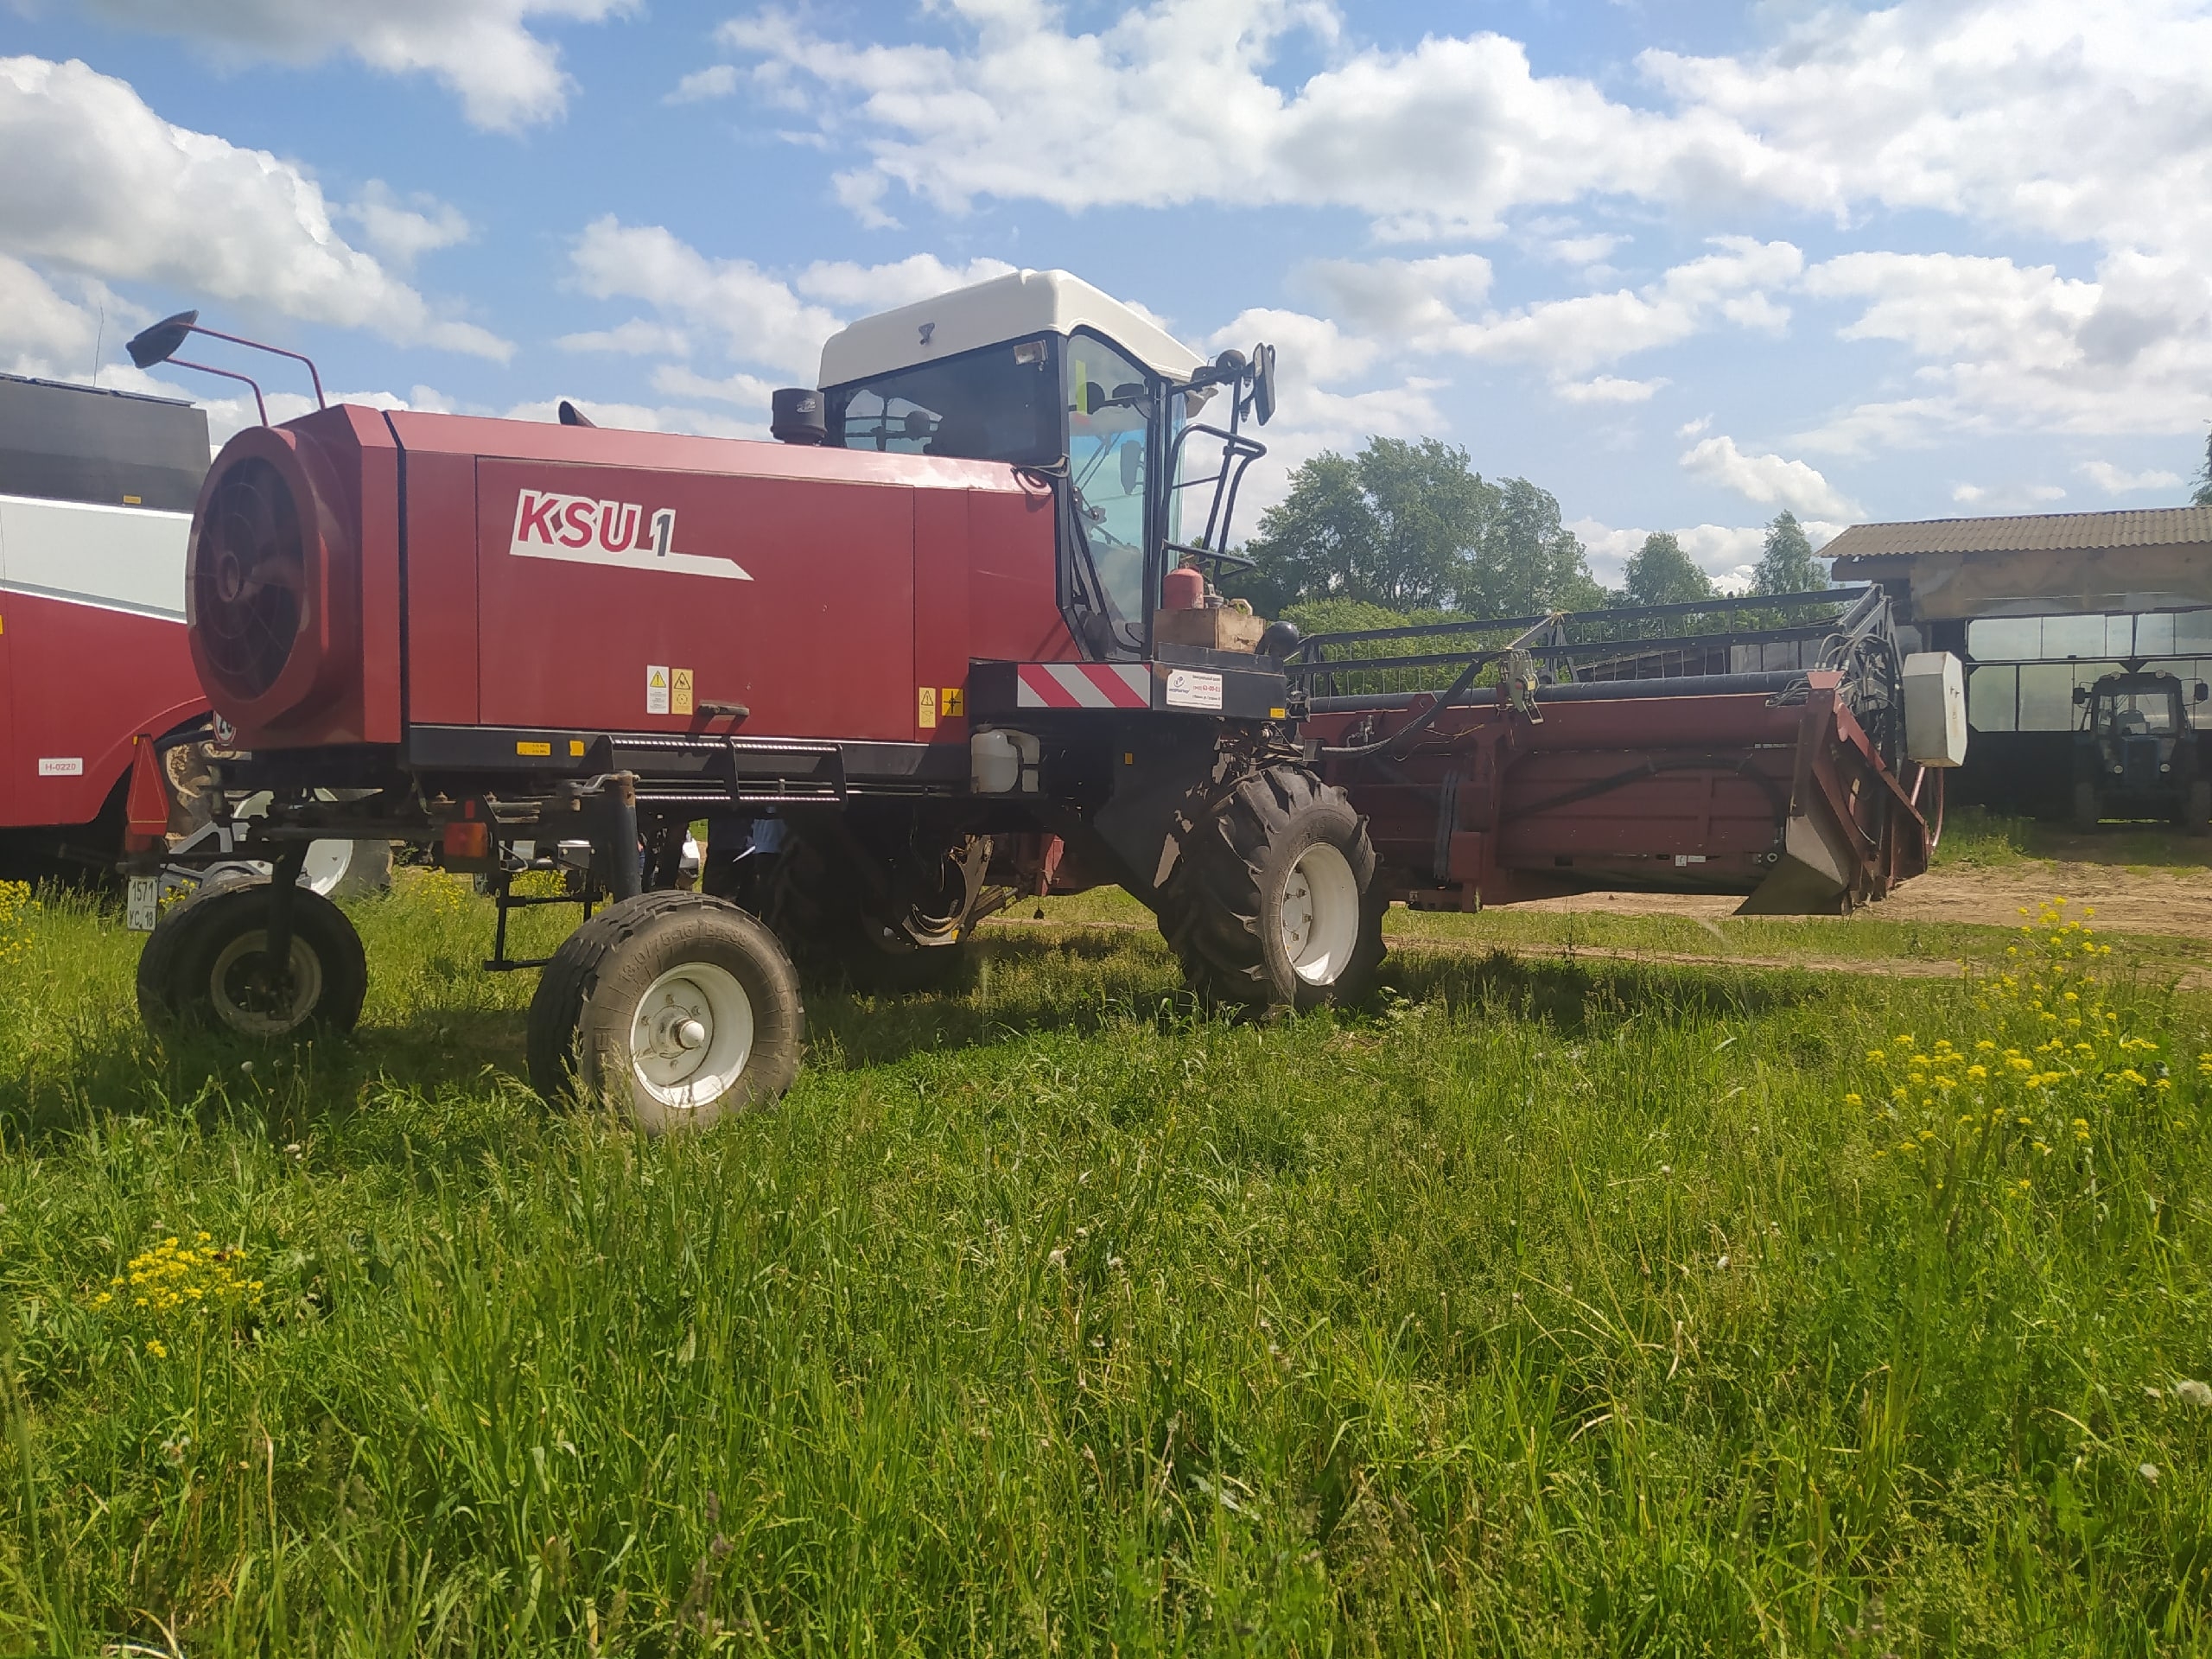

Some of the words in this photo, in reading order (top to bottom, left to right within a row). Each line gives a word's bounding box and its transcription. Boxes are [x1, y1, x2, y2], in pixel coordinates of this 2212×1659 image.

[518, 494, 637, 553] KSU
[655, 513, 671, 557] 1
[132, 881, 154, 902] 1571
[145, 911, 154, 927] 18
